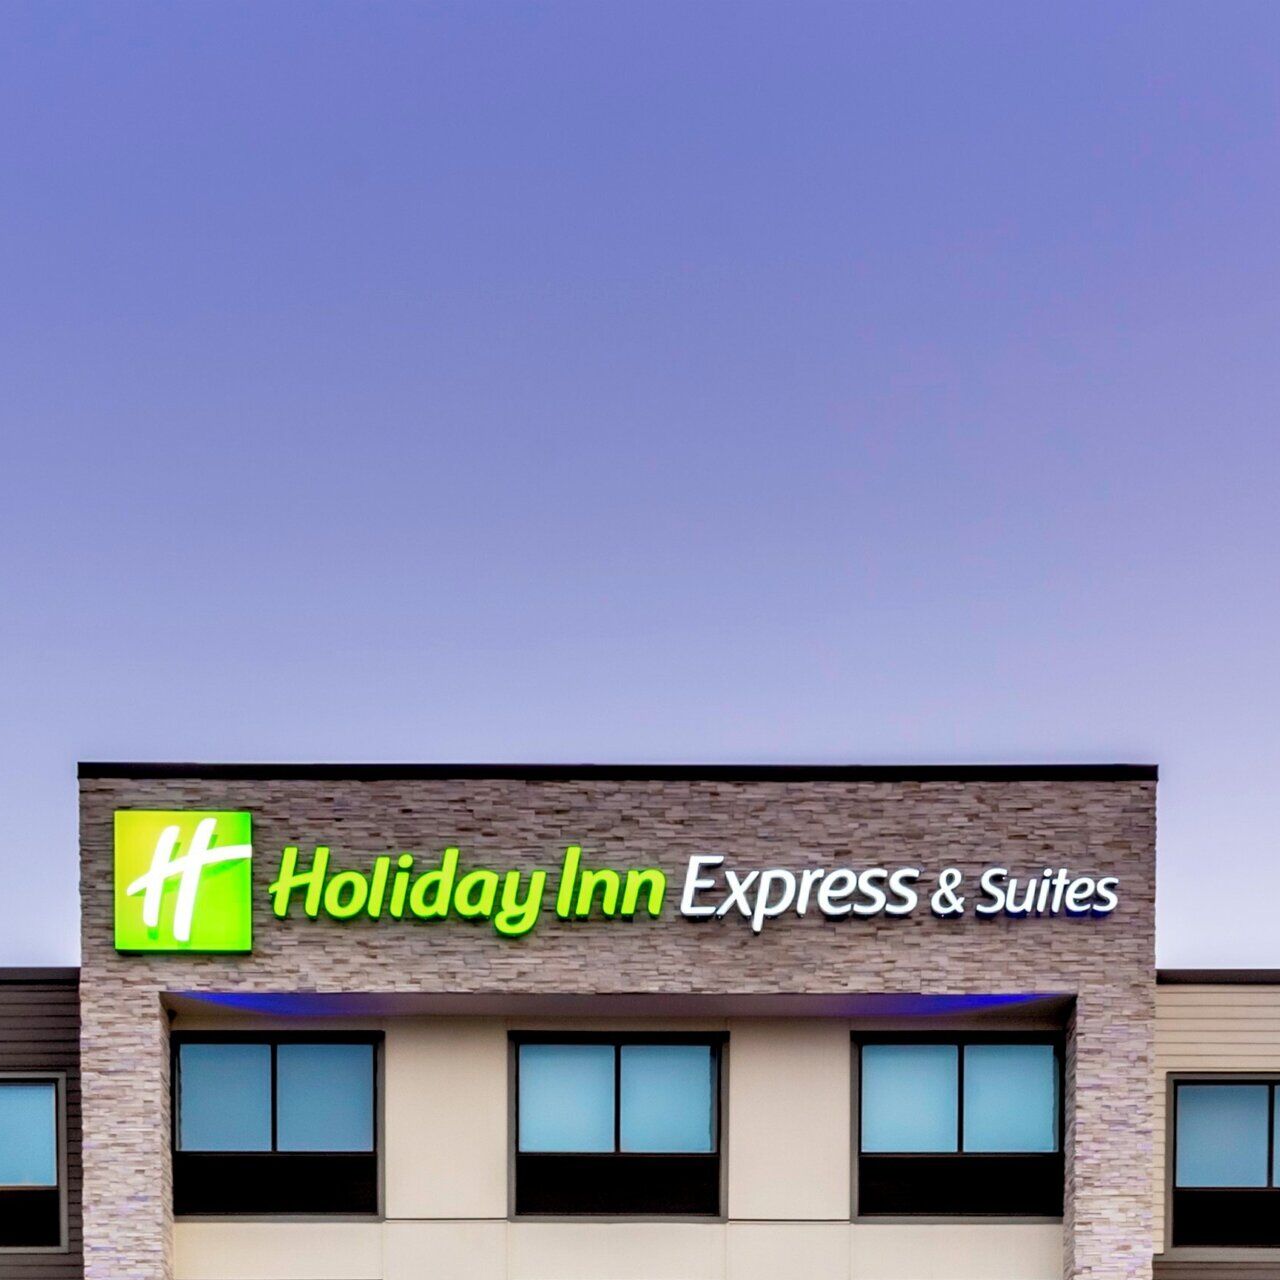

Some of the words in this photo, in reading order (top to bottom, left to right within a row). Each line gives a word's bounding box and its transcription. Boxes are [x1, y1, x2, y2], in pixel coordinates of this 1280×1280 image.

[126, 816, 252, 941] H
[268, 846, 547, 936] Holiday
[556, 846, 667, 917] Inn
[679, 854, 921, 933] Express
[930, 867, 966, 915] &
[975, 867, 1119, 914] Suites
